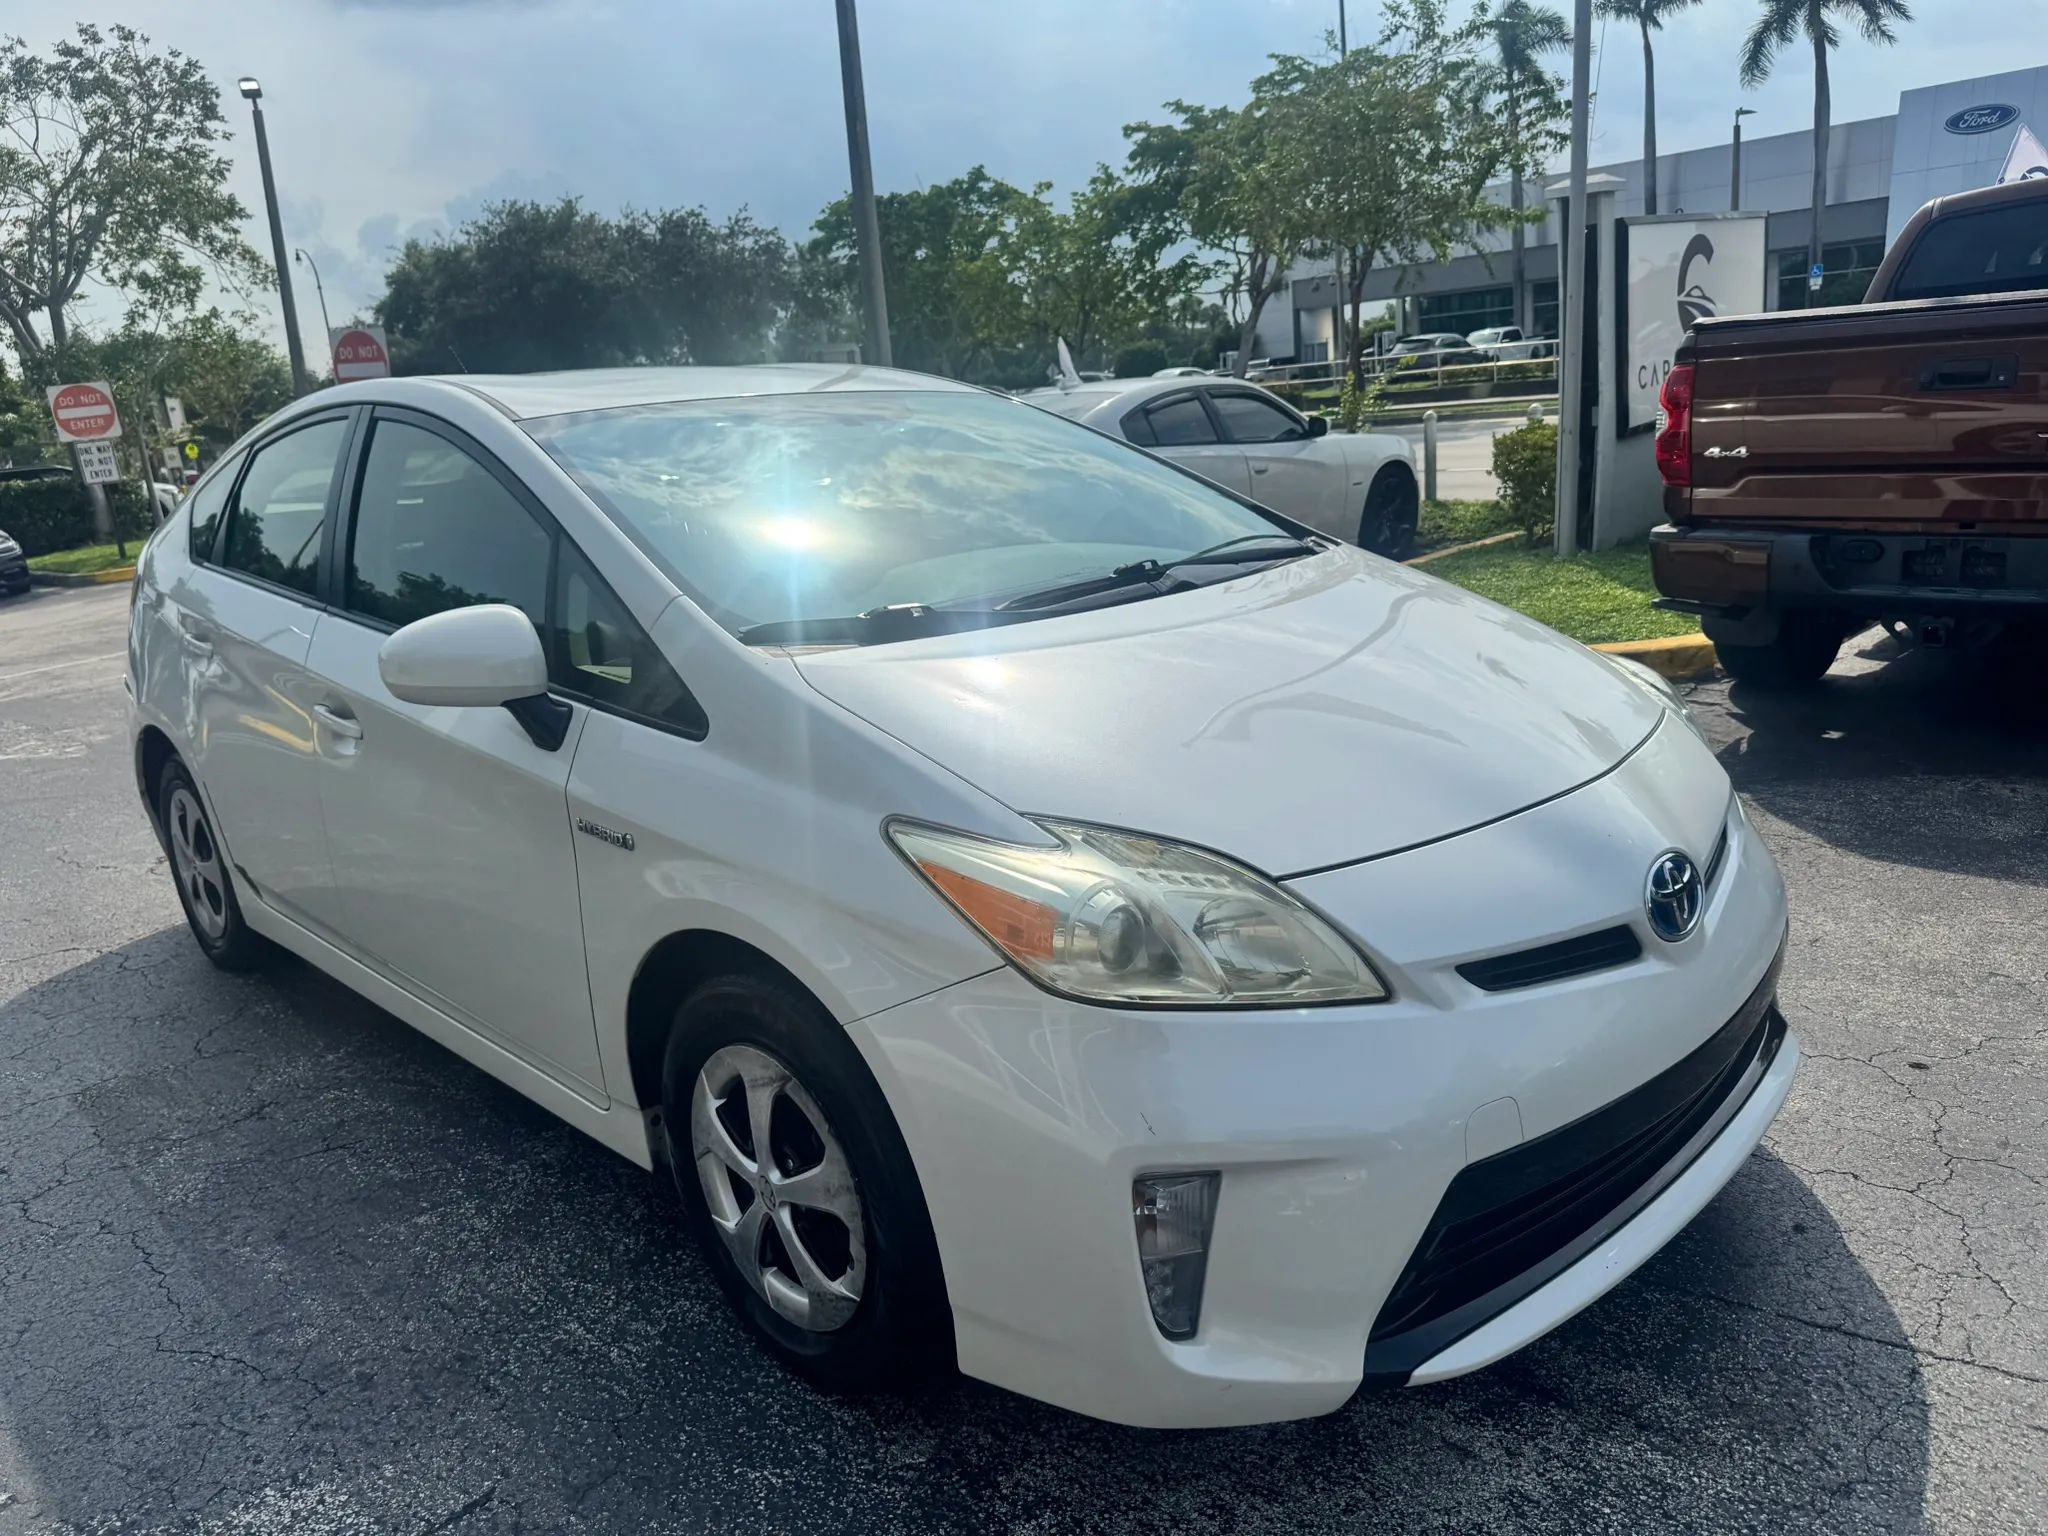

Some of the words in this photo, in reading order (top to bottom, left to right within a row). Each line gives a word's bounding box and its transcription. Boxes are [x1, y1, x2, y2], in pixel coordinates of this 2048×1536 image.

[1959, 108, 2001, 128] Ford
[339, 347, 353, 359] DO
[358, 345, 378, 358] NOT
[59, 396, 74, 407] DO
[80, 393, 101, 404] NOT
[70, 418, 105, 430] ENTER
[80, 446, 93, 456] ONE
[96, 444, 111, 454] WAY
[1703, 446, 1750, 458] 4x4
[83, 458, 94, 467] DO
[98, 456, 112, 465] NOT
[90, 469, 112, 479] ENTER
[576, 817, 624, 847] HYBRID
